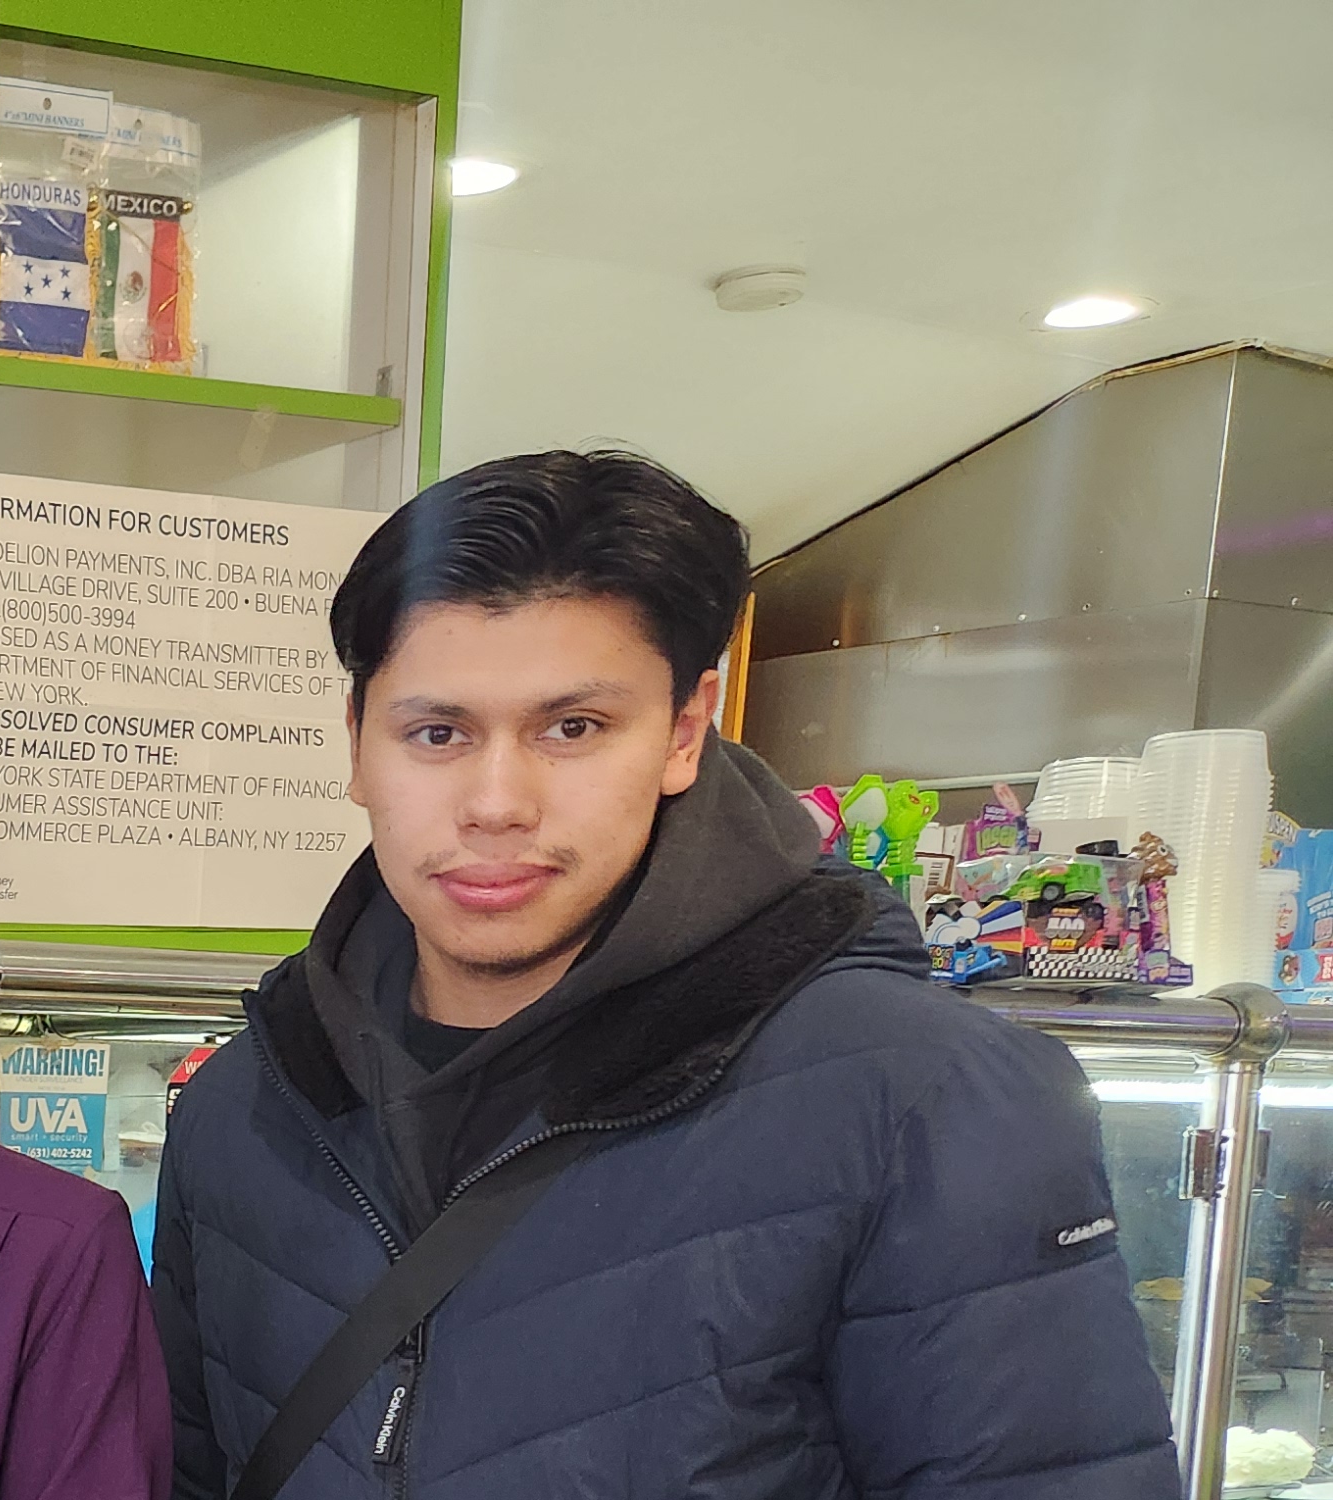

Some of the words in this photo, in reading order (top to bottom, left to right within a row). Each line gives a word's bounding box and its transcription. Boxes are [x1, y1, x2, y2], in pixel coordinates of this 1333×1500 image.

[0, 181, 81, 207] HONDURAS
[104, 193, 178, 217] MEXICO
[108, 509, 152, 533] FOR
[159, 514, 289, 546] CUSTOMERS
[65, 549, 170, 580] PAYMENTS,
[175, 559, 212, 582] INC.
[218, 562, 257, 585] DBA
[262, 567, 293, 588] RIA
[0, 569, 77, 597] VILLAGE
[82, 577, 142, 605] DRIVE,
[147, 584, 199, 608] SUITE
[205, 588, 239, 610] 200
[255, 592, 319, 617] BUENA
[43, 630, 69, 651] AS
[73, 632, 88, 654] A
[93, 634, 162, 659] MONEY
[166, 640, 300, 668] TRANSMITTER
[305, 649, 329, 670] BY
[80, 661, 107, 682] OF
[111, 662, 209, 689] FINANCIAL
[213, 670, 304, 695] SERVICES
[308, 676, 334, 696] OF
[31, 683, 89, 707] YORK.
[84, 714, 195, 740] CONSUMER
[201, 721, 325, 746] COMPLAINTS
[21, 738, 96, 762] MAILED
[102, 742, 128, 763] TO
[134, 744, 178, 766] THE:
[48, 767, 106, 790] STATE
[110, 770, 239, 795] DEPARTMENT
[243, 776, 269, 796] OF
[52, 795, 171, 820] ASSISTANCE
[176, 801, 224, 821] UNIT:
[97, 824, 162, 846] PLAZA
[179, 826, 258, 851] ALBANY,
[263, 830, 290, 850] NY
[294, 831, 347, 852] 12257
[2, 1047, 106, 1077] WARNING!
[10, 1097, 88, 1134] UVA
[50, 1134, 88, 1144] security
[51, 1148, 92, 1159] 402-5242
